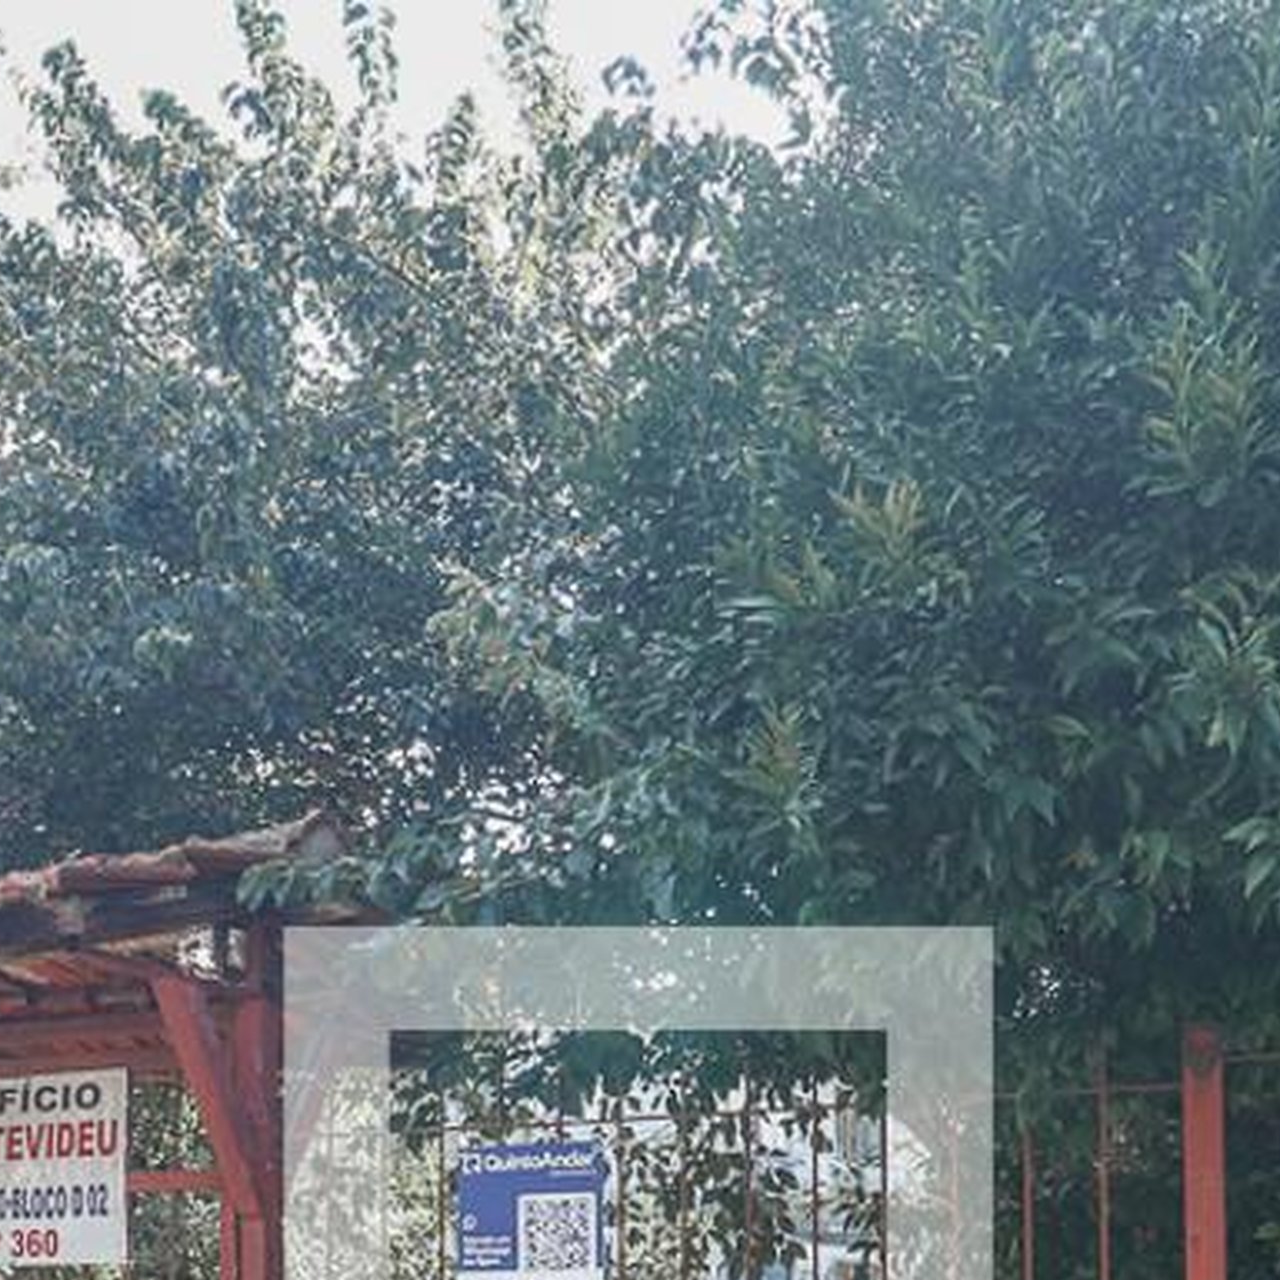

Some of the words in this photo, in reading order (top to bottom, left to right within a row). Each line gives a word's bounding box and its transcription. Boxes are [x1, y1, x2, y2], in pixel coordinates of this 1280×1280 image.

[72, 1183, 84, 1216] D
[86, 1183, 109, 1217] 02
[12, 1229, 58, 1257] 360
